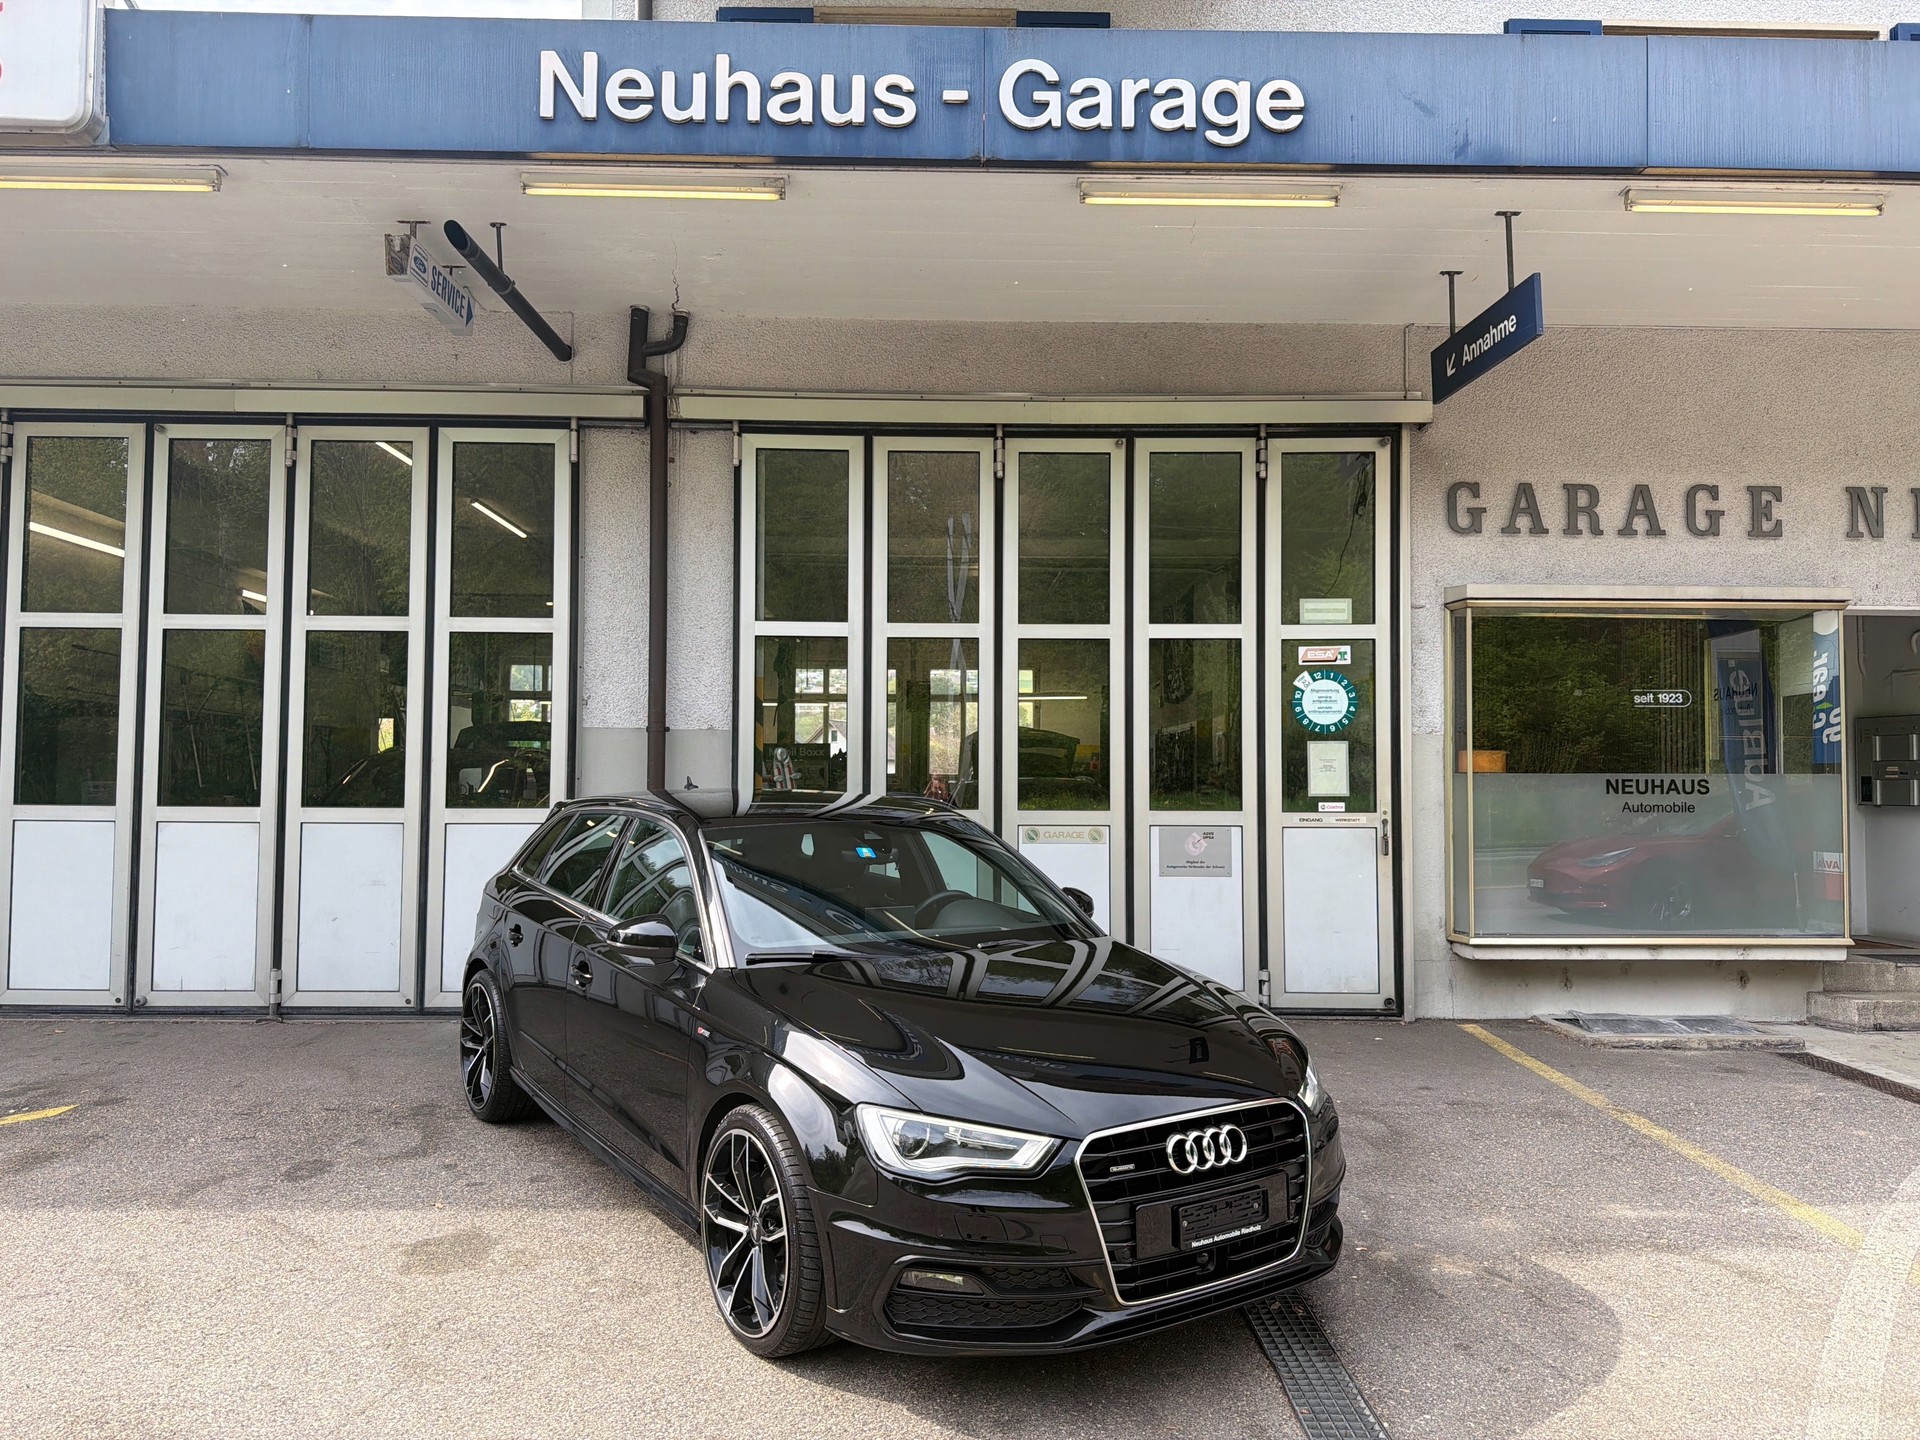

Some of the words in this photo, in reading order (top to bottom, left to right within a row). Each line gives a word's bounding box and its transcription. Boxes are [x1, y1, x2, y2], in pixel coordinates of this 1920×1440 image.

[539, 49, 918, 128] Neuhaus
[999, 57, 1305, 147] Garage
[430, 265, 466, 320] SERVICE
[1462, 314, 1517, 367] Annahme
[1447, 481, 1783, 538] GARAGE
[1313, 671, 1322, 679] 12
[1340, 679, 1348, 687] 2
[1633, 693, 1655, 703] seit
[1657, 693, 1683, 703] 1923
[1341, 717, 1349, 725] 5
[1605, 778, 1710, 795] NEUHAUS
[1622, 801, 1696, 813] Automobile
[1043, 831, 1085, 839] GARAGE
[1191, 1237, 1213, 1248] Neuhaus
[1213, 1229, 1241, 1242] Automobile
[1240, 1224, 1262, 1235] Riedholz
